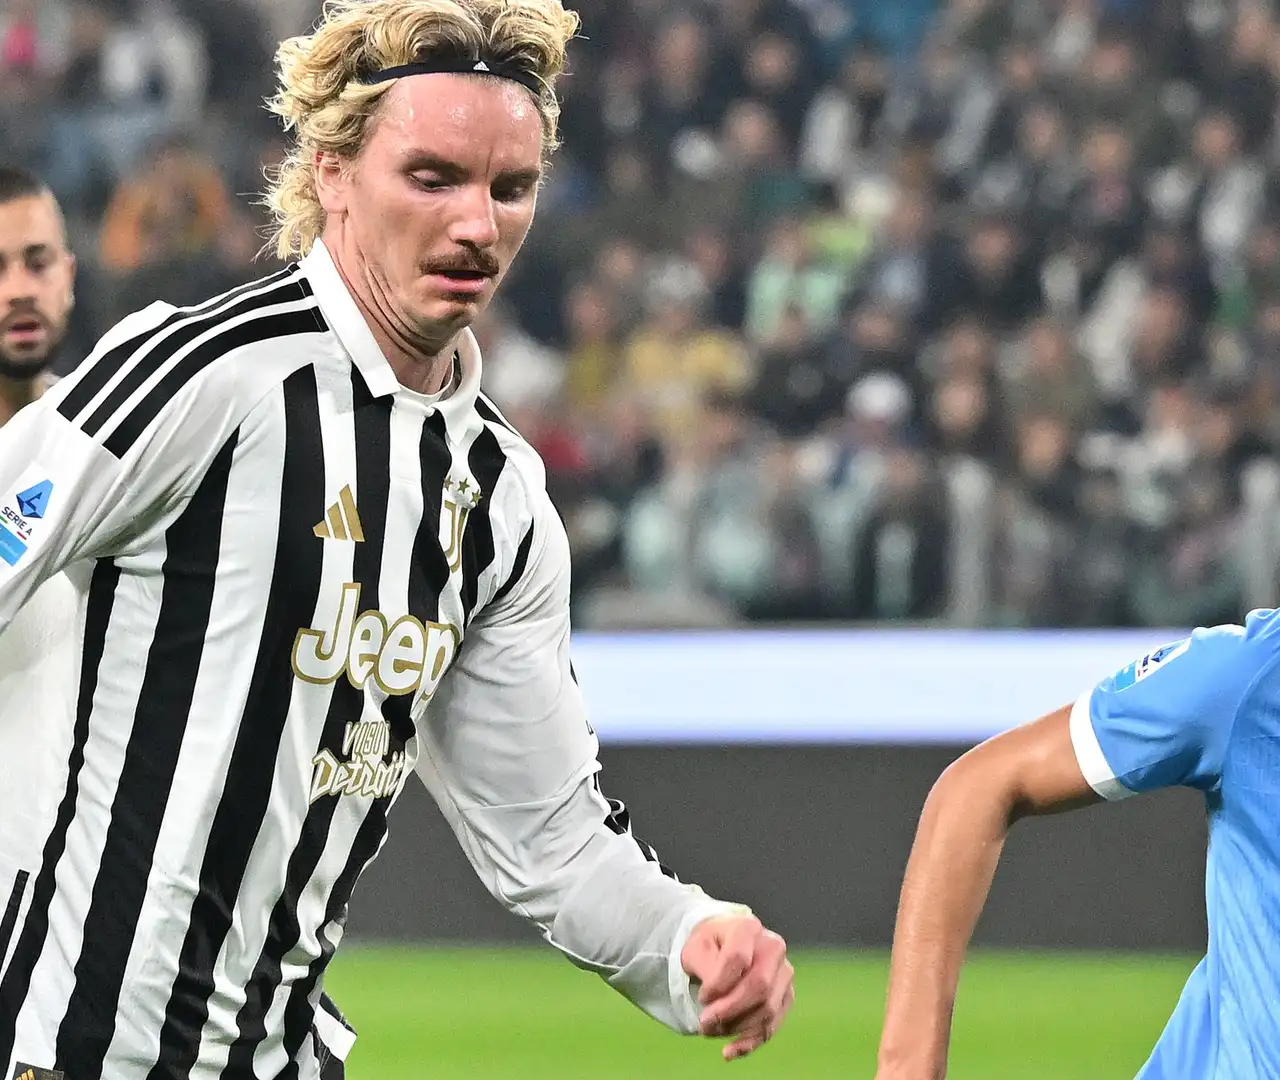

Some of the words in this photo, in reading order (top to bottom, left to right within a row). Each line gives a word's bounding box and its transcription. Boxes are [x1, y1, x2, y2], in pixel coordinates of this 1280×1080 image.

[1, 506, 28, 530] SERIE
[26, 527, 33, 536] A
[291, 582, 461, 700] Jeep
[308, 747, 405, 805] Detroit
